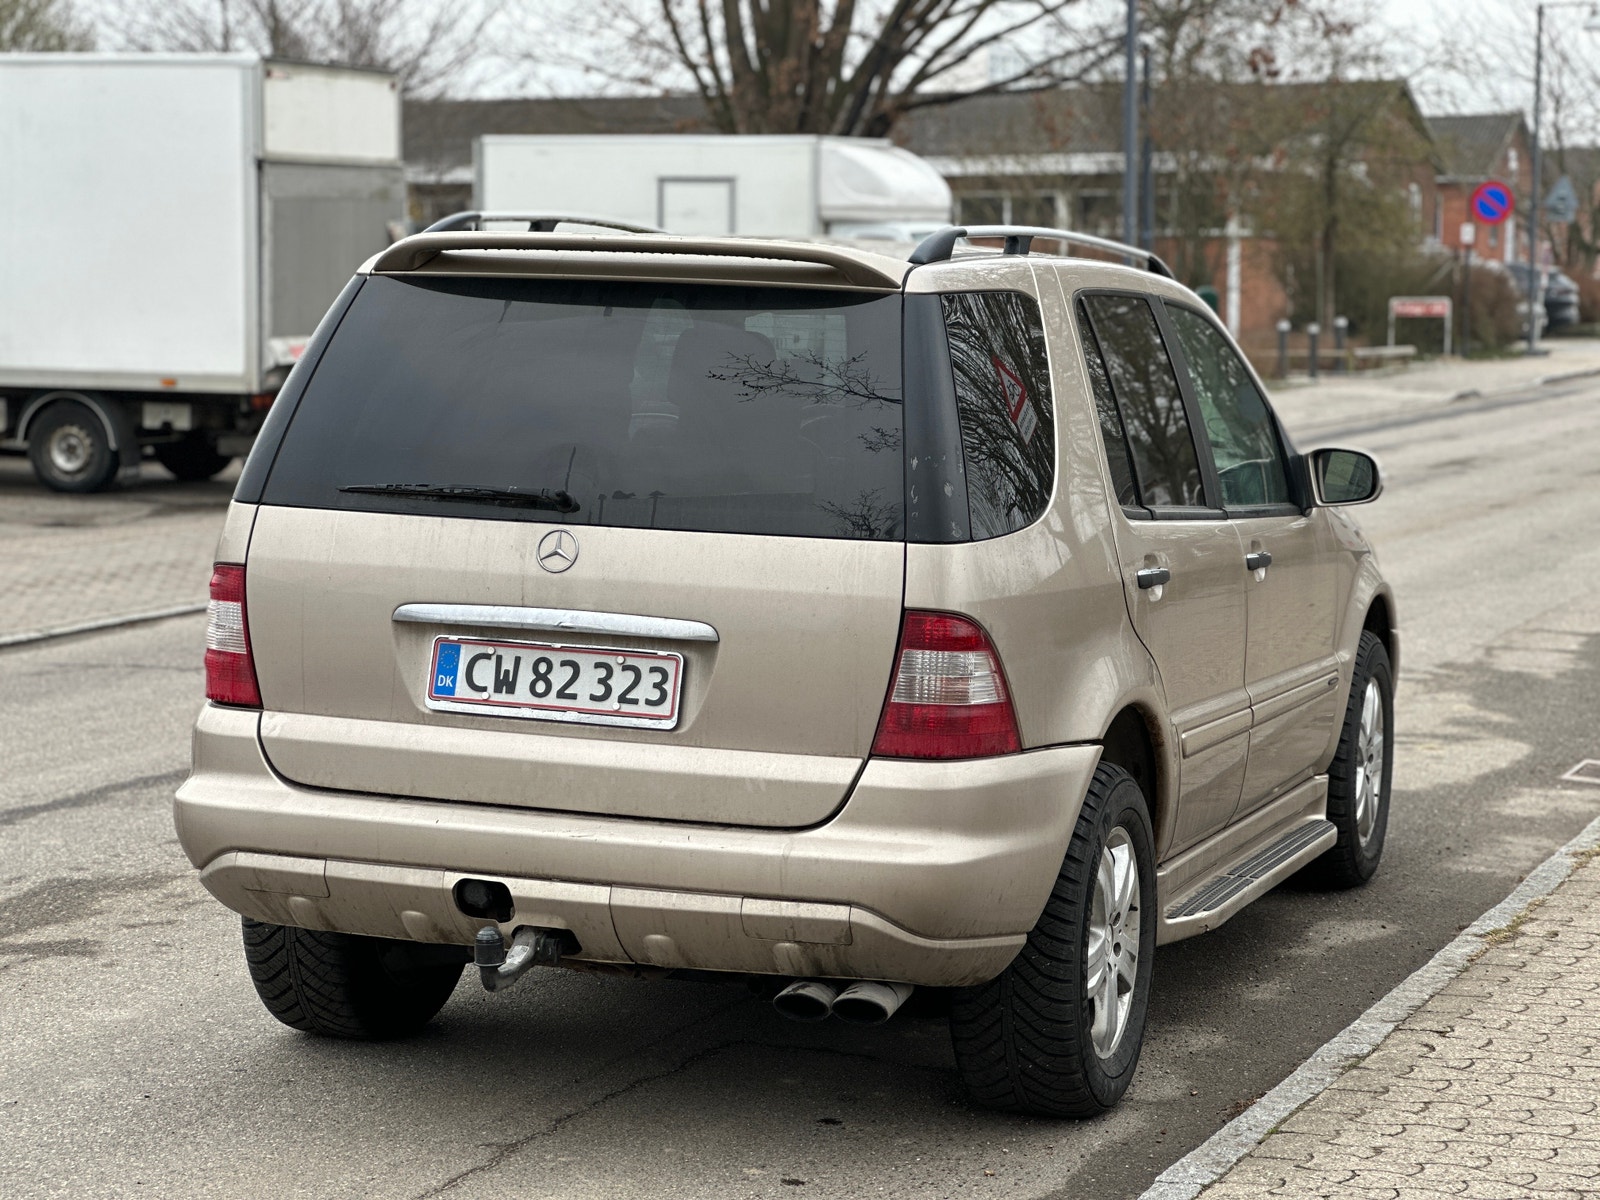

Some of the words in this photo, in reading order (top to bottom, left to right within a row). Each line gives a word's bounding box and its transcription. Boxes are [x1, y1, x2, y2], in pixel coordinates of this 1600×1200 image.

[437, 675, 454, 688] DK
[465, 653, 521, 694] CW
[529, 656, 581, 700] 82
[589, 662, 669, 706] 323
